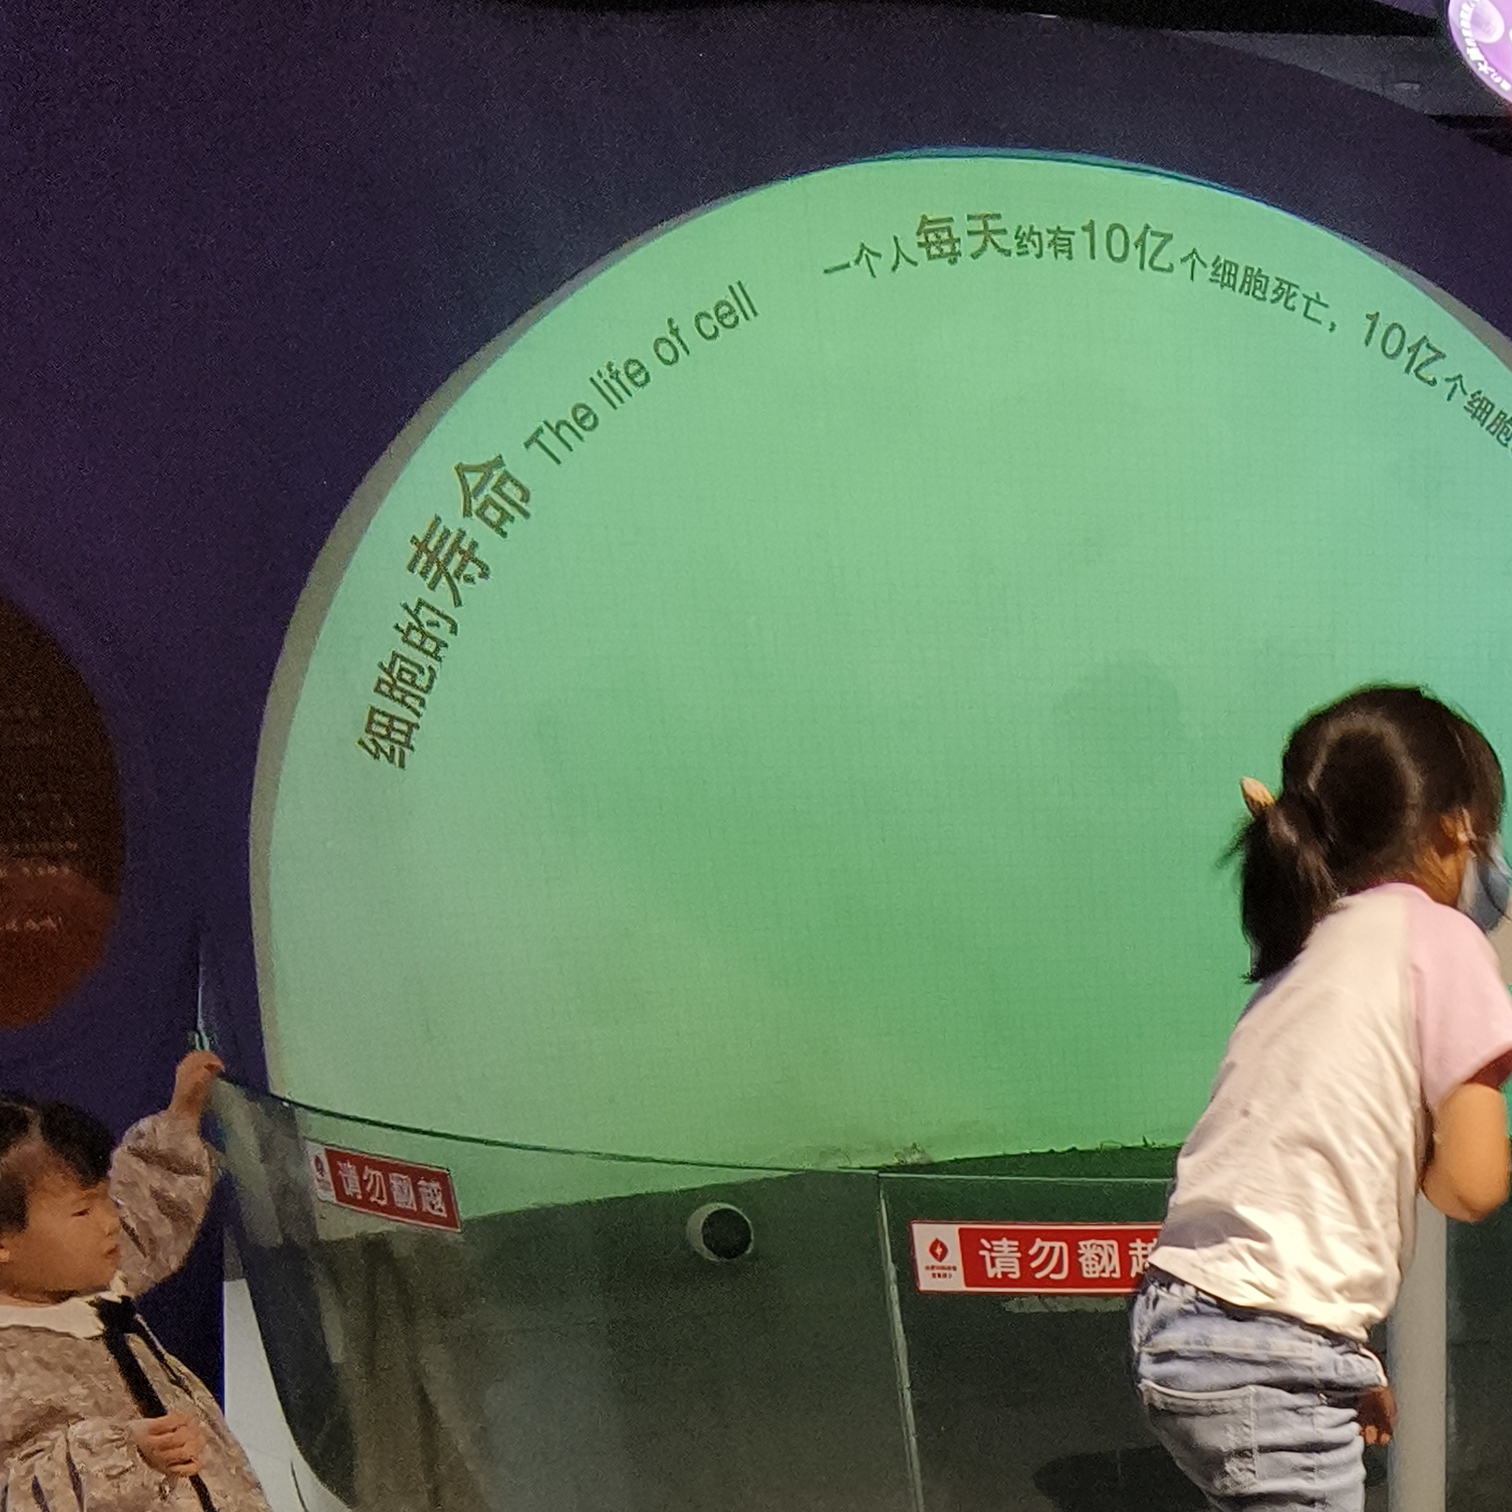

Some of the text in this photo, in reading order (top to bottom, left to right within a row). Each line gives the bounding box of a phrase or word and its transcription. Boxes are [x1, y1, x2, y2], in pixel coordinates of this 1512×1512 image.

[523, 279, 760, 466] The life of cell
[357, 453, 532, 772] 细胞的寿命
[336, 1160, 448, 1218] 请勿翻越
